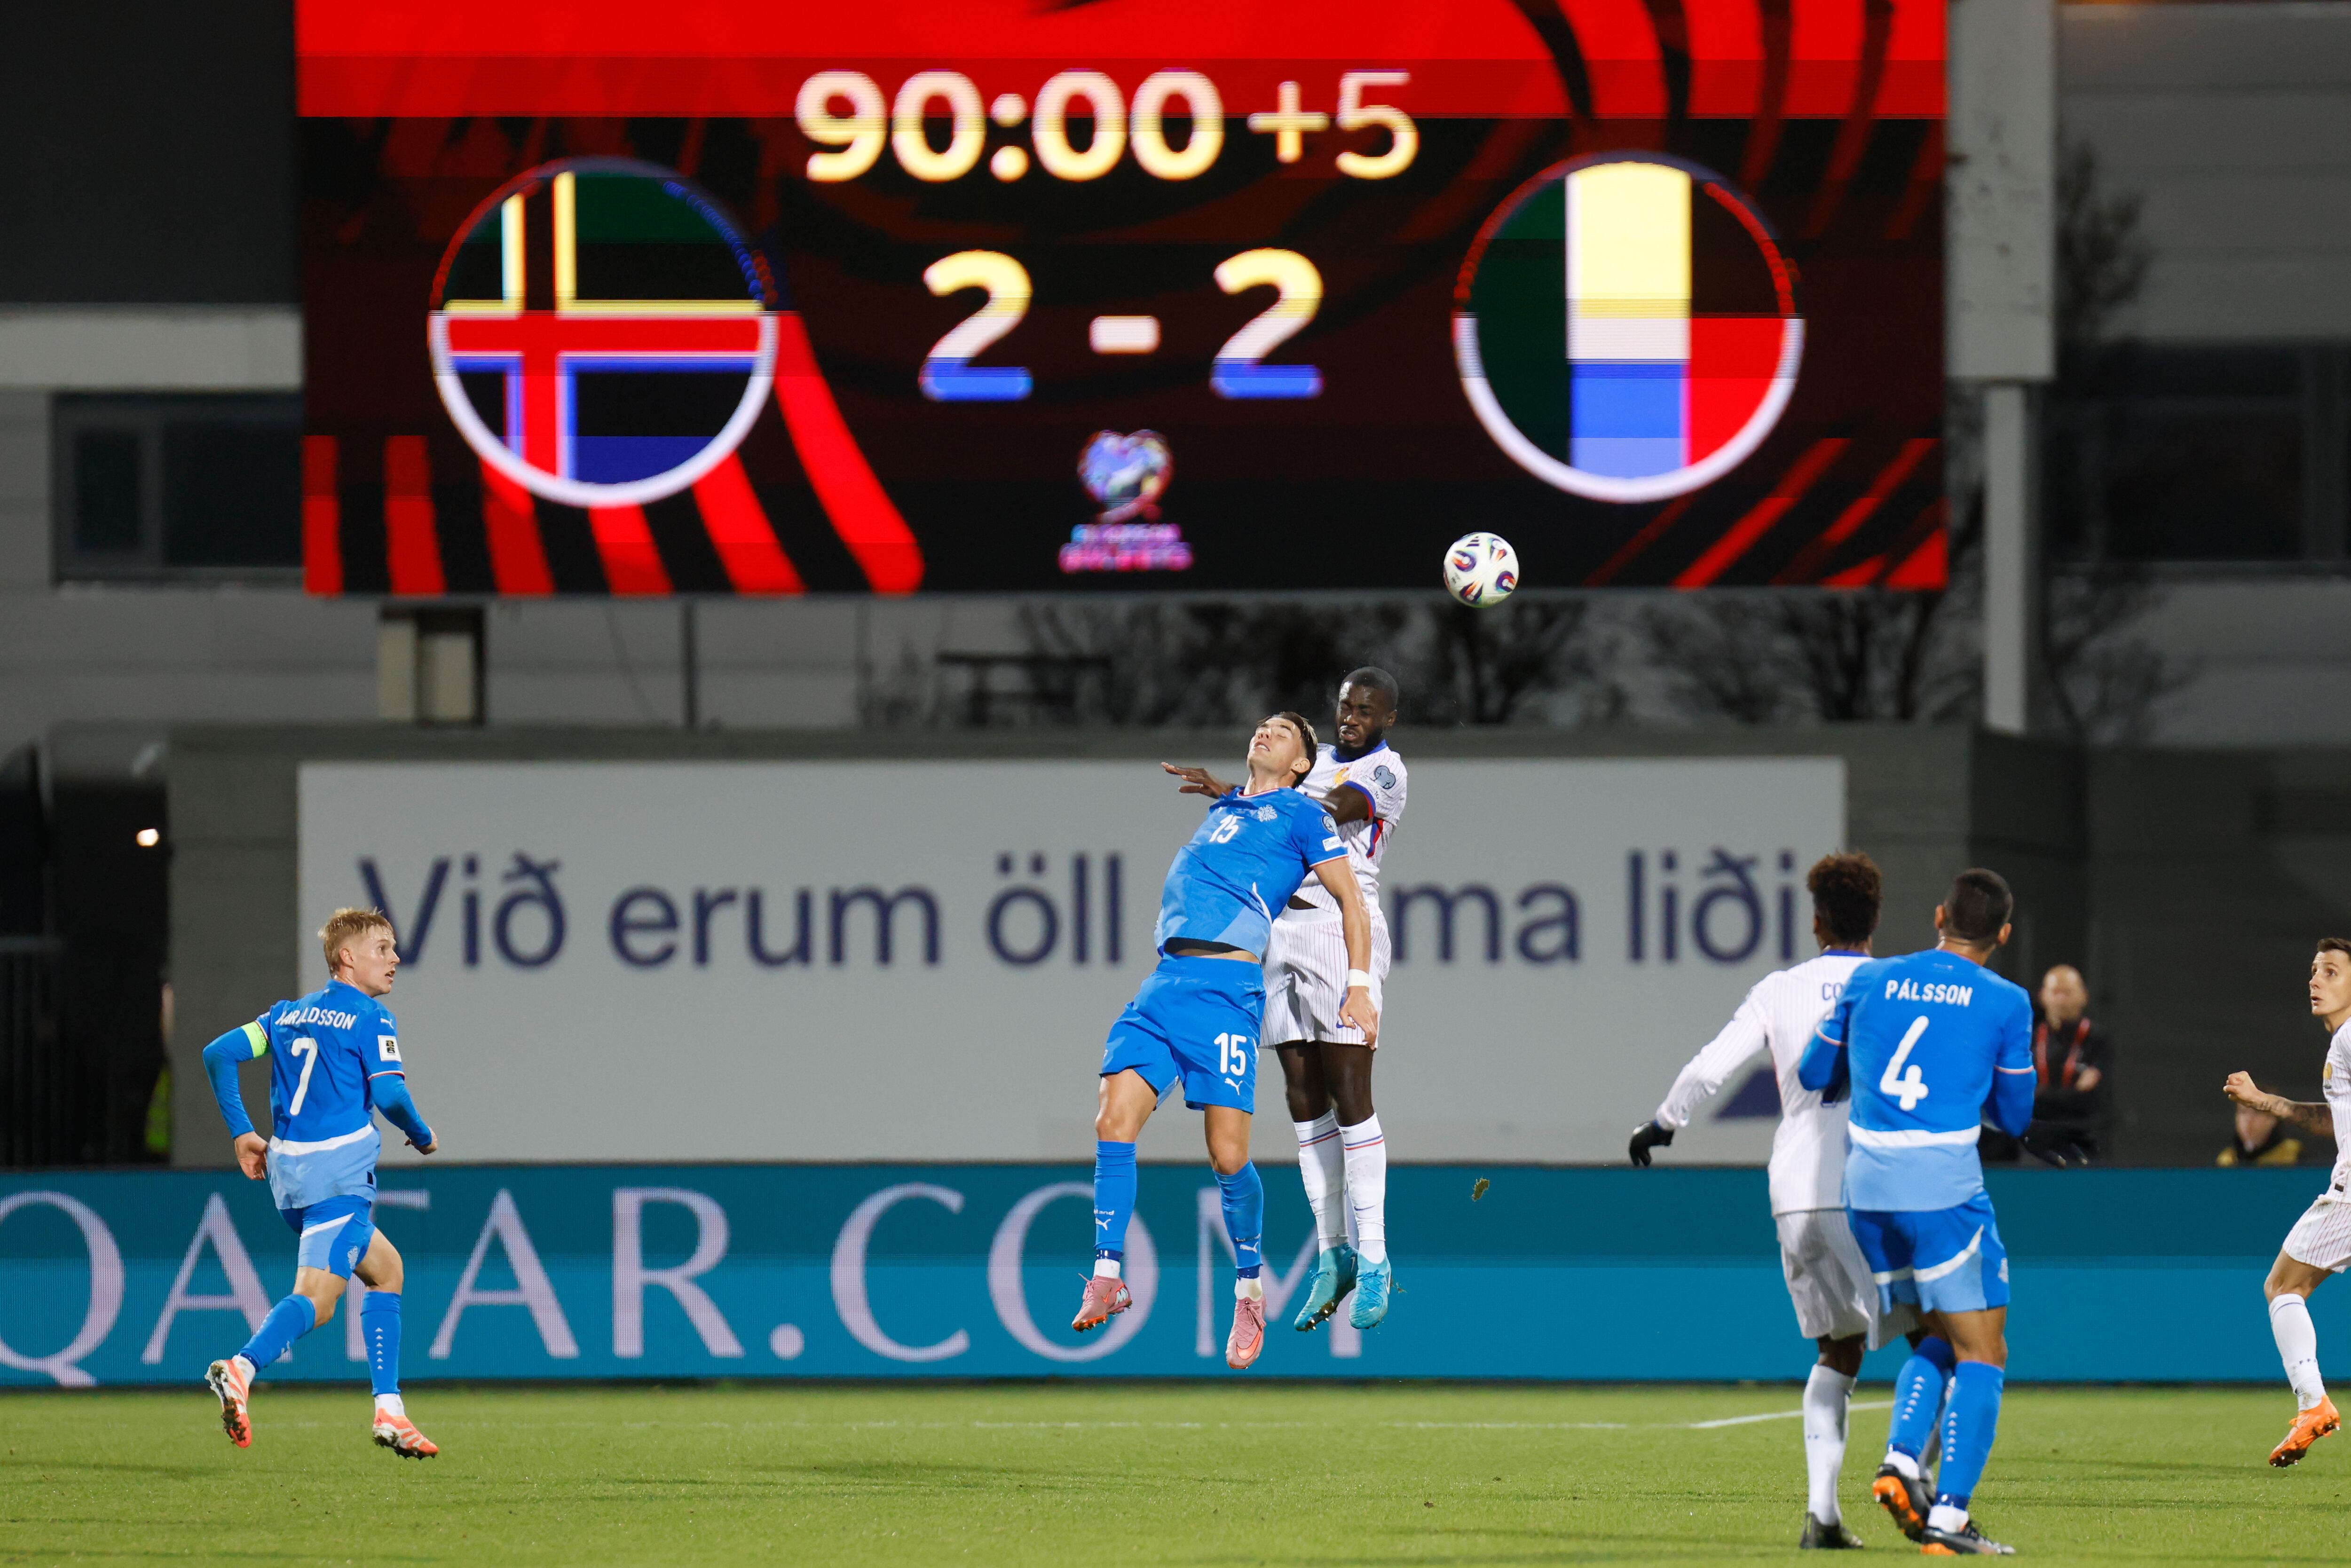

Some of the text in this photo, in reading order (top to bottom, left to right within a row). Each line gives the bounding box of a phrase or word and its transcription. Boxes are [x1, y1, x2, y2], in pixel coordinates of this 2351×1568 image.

[795, 69, 1420, 182] 90:00 +5
[919, 248, 1033, 402] 2
[1209, 247, 1324, 399] 2
[1209, 814, 1245, 843] 15
[357, 848, 1798, 969] Við erum öll ma liði
[1885, 977, 1973, 1007] PÁLSSON
[290, 1037, 318, 1116] 7
[1214, 1032, 1247, 1076] 15
[1880, 1015, 1930, 1111] 4
